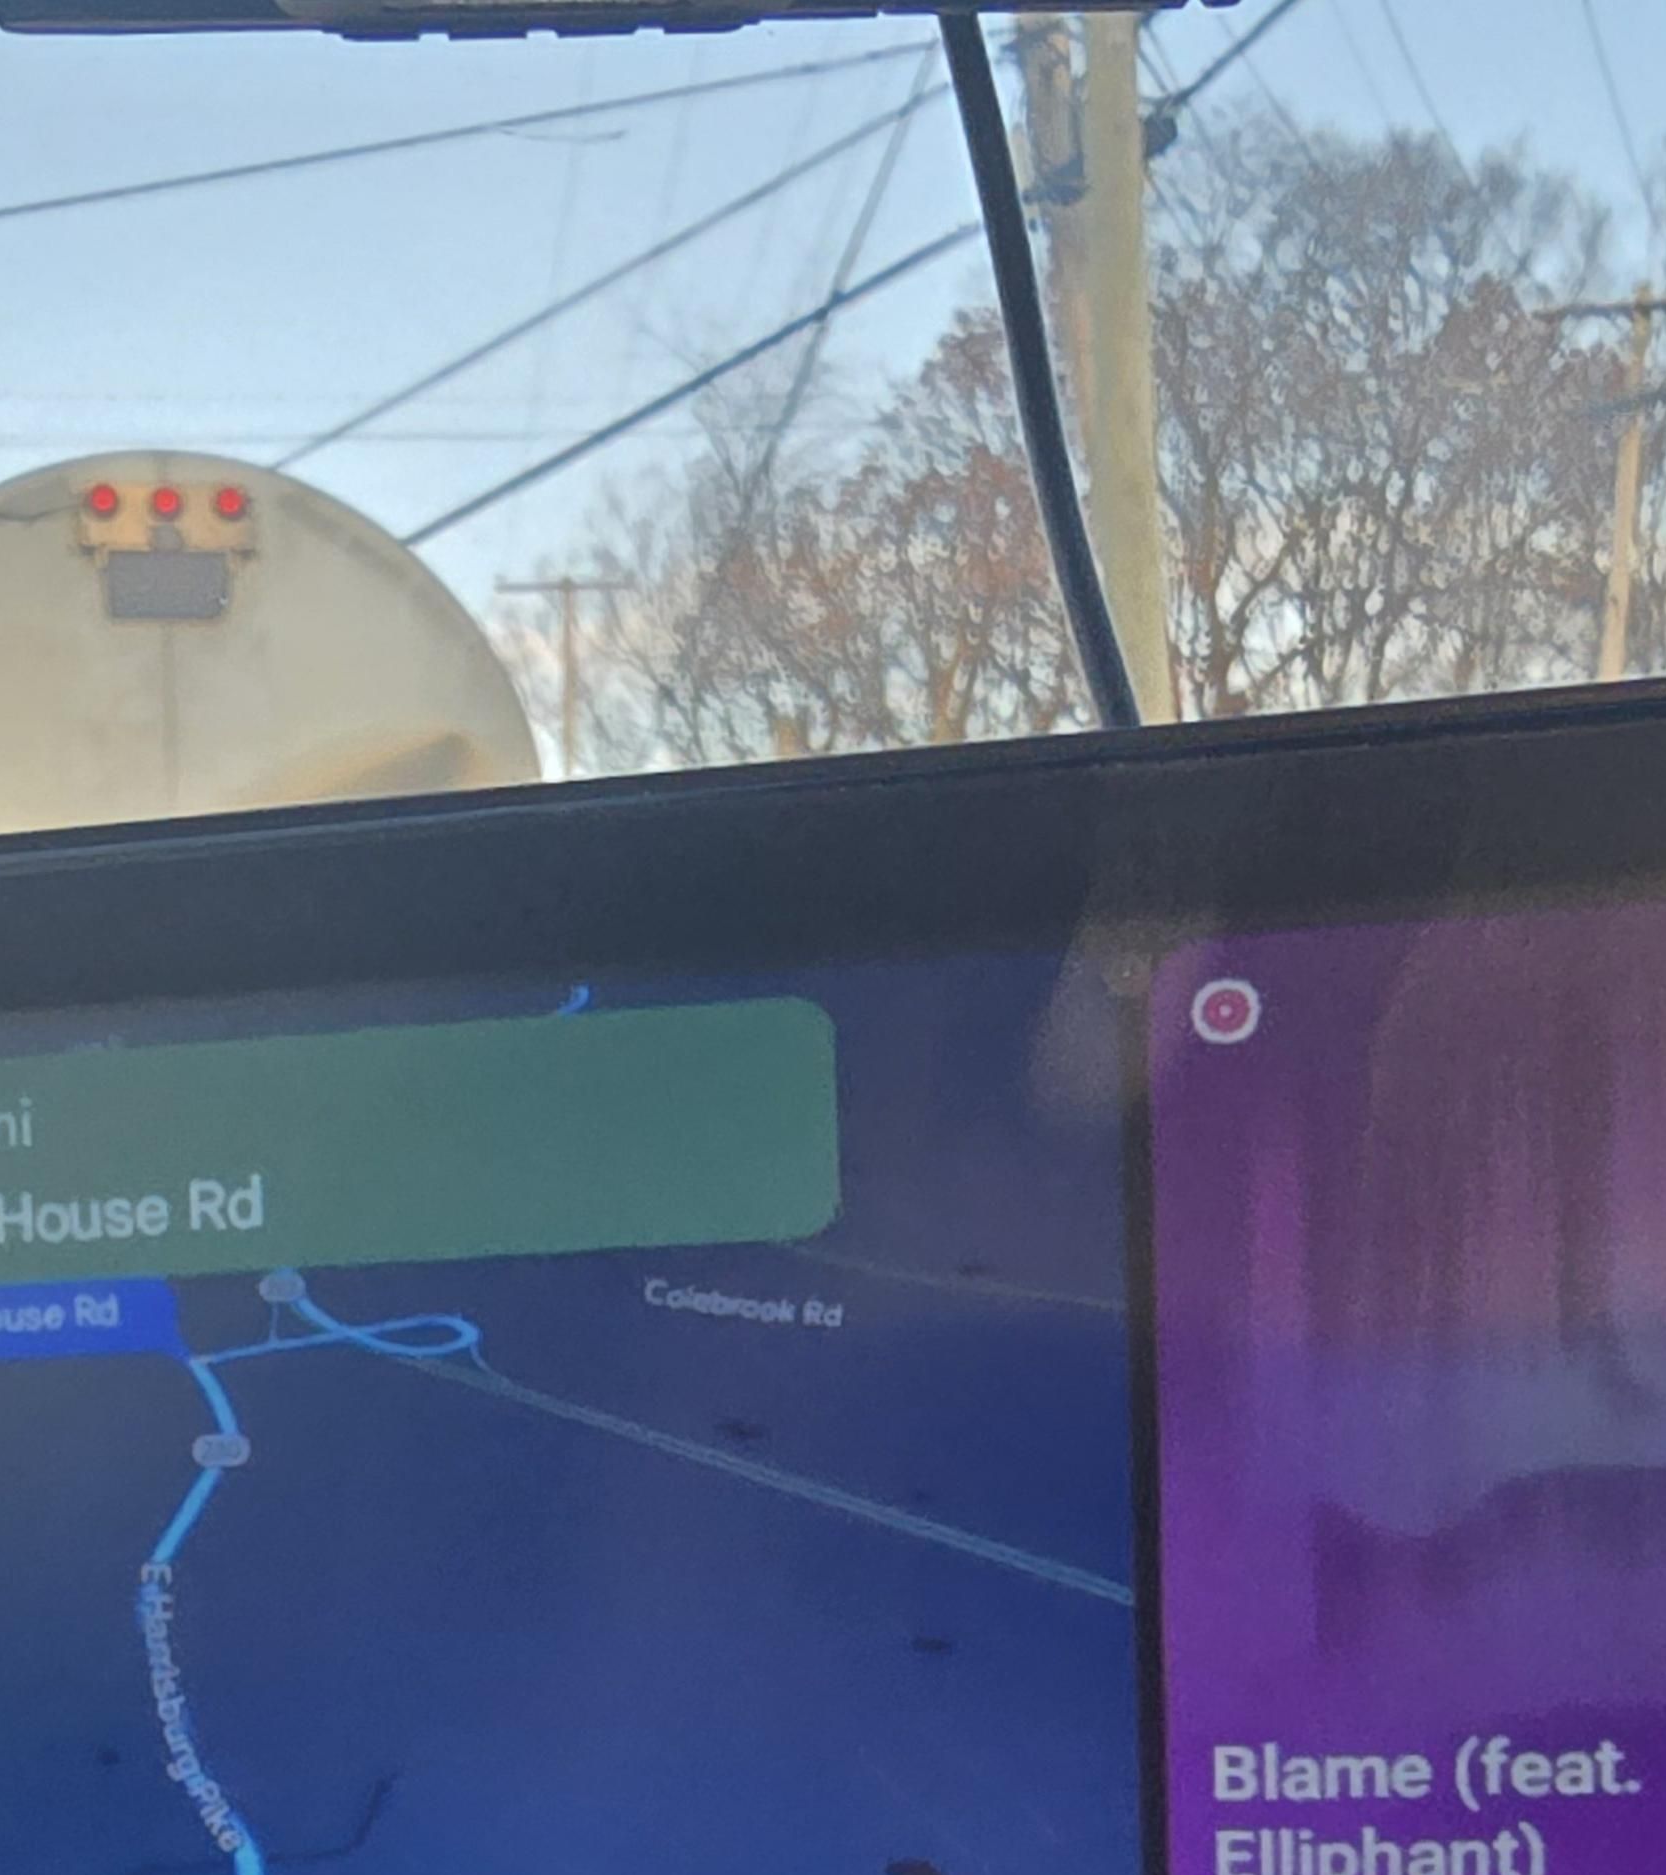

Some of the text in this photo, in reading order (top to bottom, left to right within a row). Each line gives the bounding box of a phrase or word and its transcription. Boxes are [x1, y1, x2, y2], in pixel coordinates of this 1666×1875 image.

[189, 1173, 264, 1231] Rd
[74, 1292, 119, 1327] Rd
[802, 1299, 844, 1329] Rd
[1213, 1736, 1644, 1812] Blame (feat.
